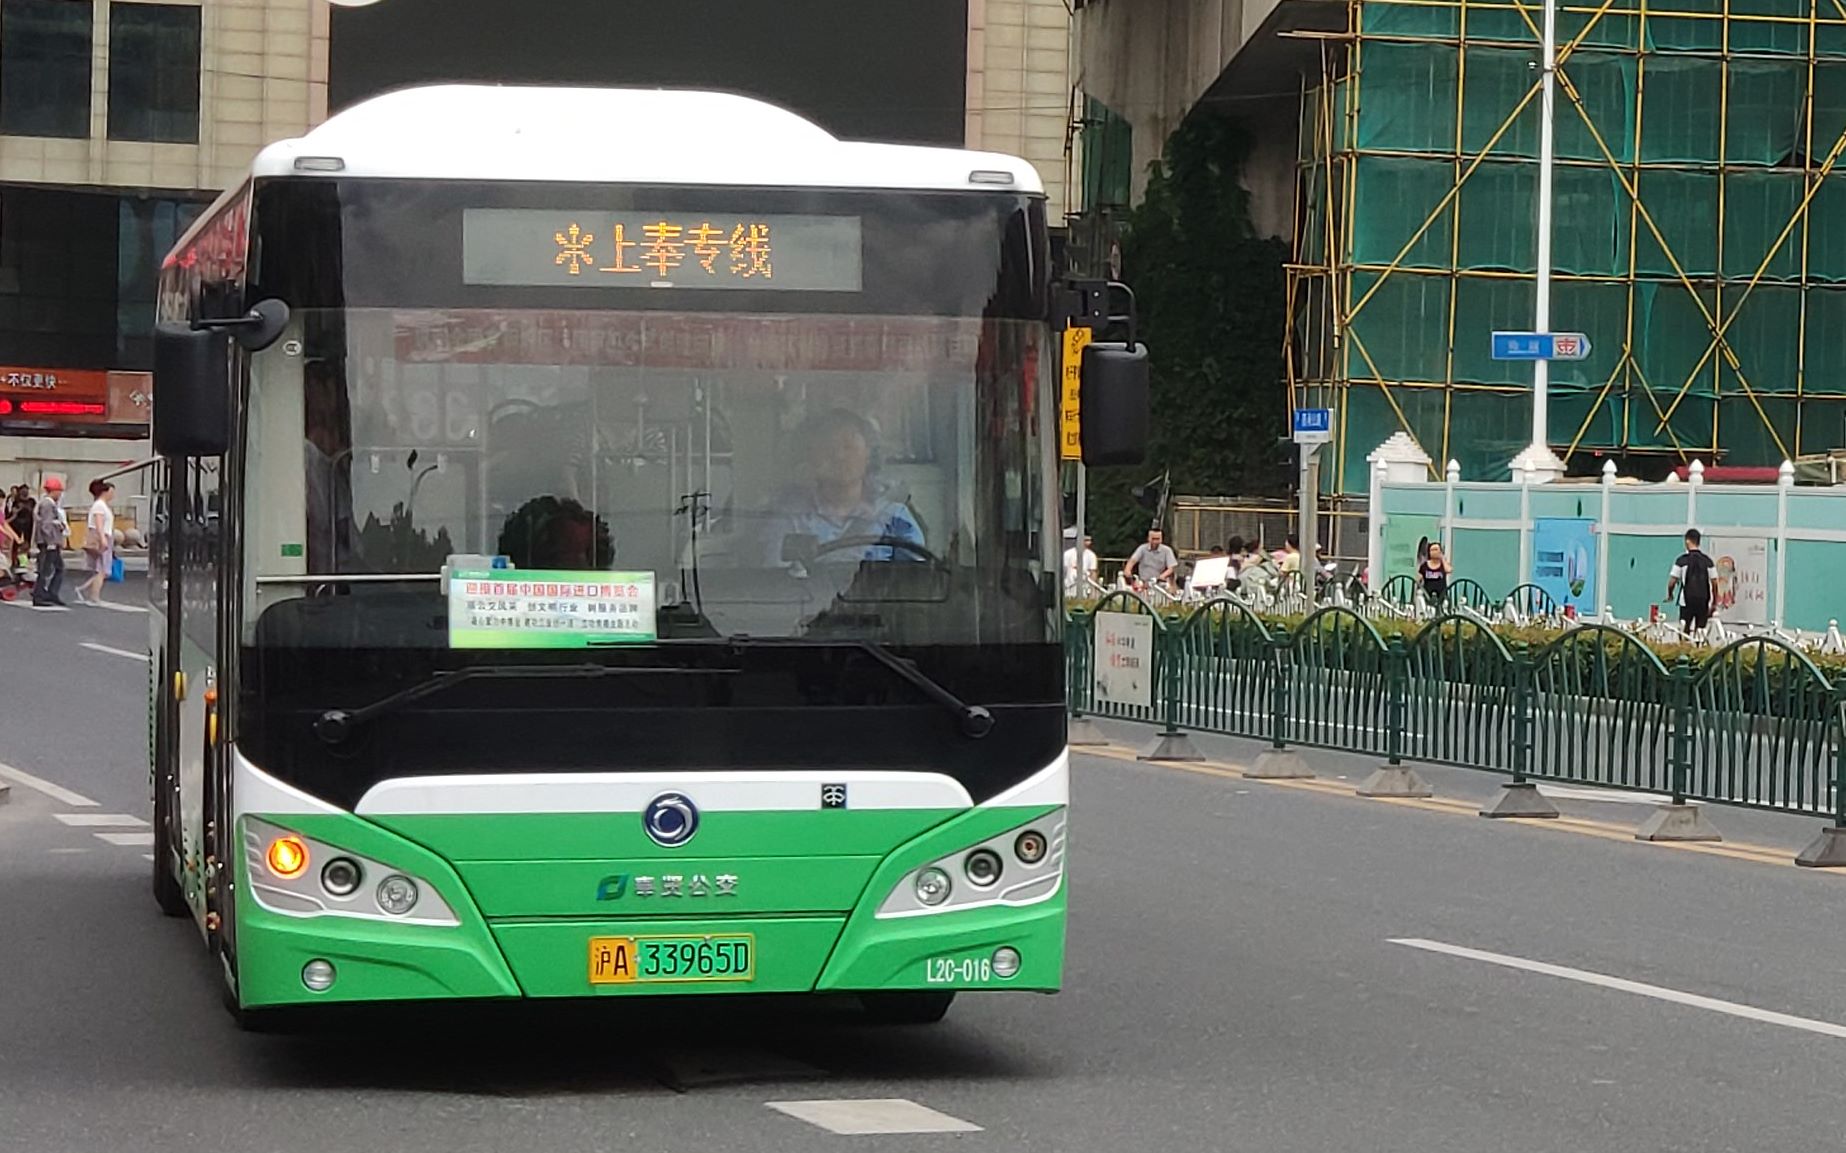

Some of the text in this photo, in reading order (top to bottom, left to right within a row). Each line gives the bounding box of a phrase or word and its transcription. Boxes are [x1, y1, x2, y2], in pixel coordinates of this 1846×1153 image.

[634, 874, 739, 898] 奉贤公交
[927, 958, 990, 982] L2C-016
